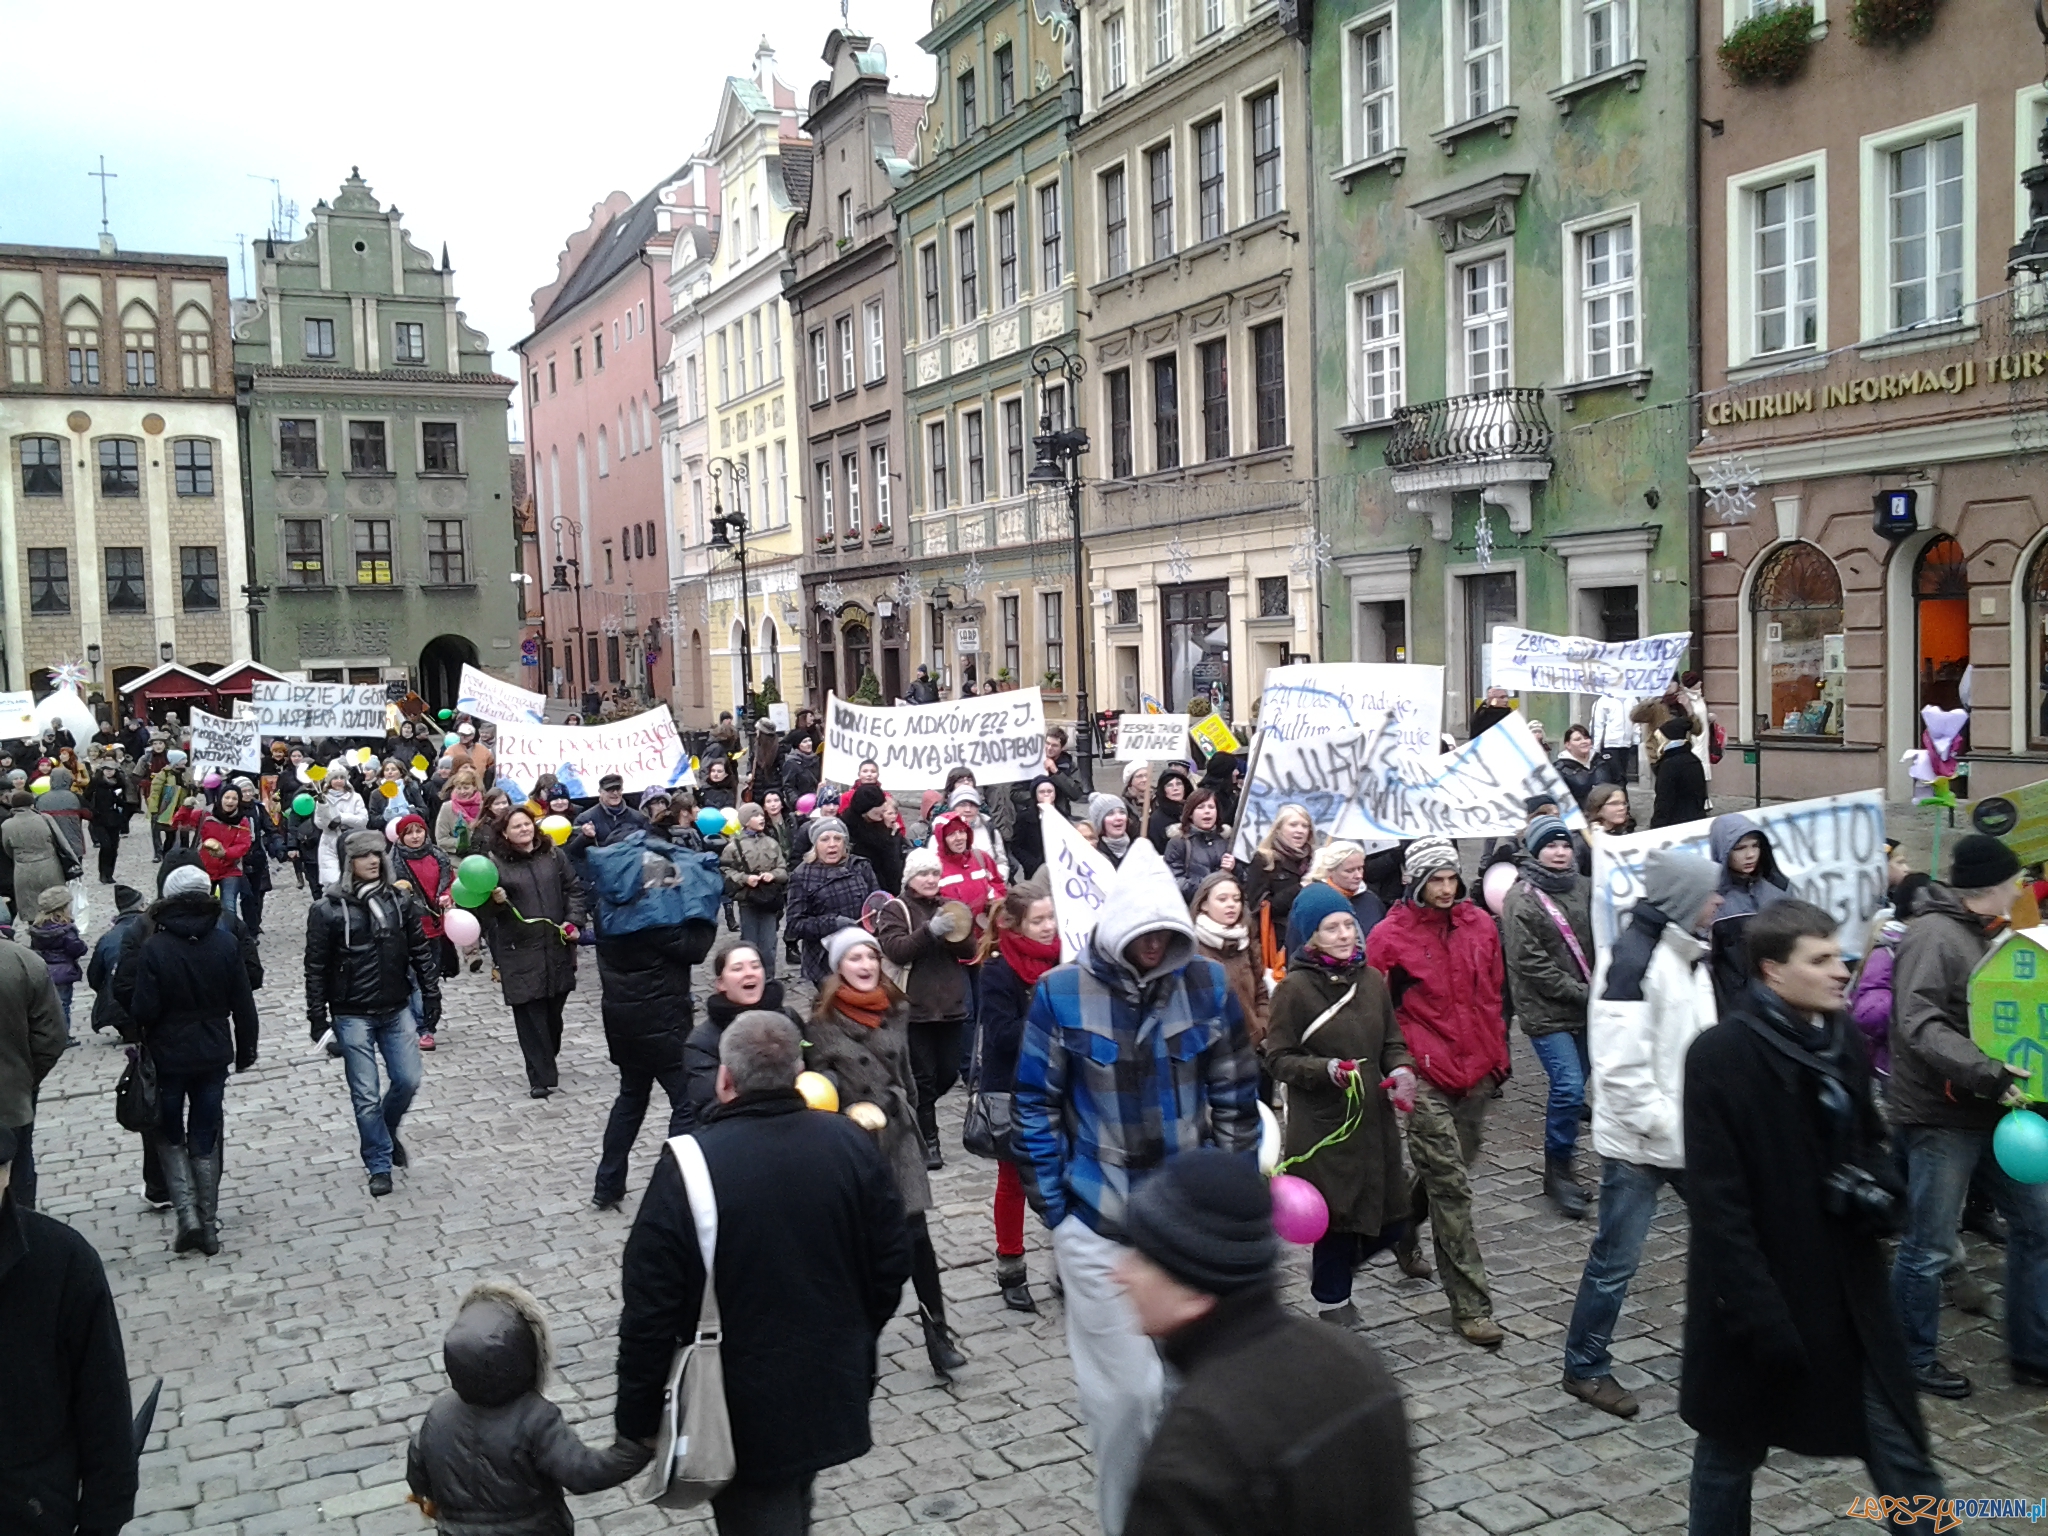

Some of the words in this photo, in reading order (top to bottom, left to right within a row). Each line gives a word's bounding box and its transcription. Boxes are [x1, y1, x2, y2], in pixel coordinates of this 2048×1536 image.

[1707, 388, 1814, 426] CENTRUM
[1821, 359, 1976, 409] INFORMACJI
[1986, 350, 2048, 384] TUR
[341, 686, 355, 704] W
[202, 715, 261, 736] RATUJMY
[834, 704, 897, 738] KONIEC
[881, 744, 943, 776] MNĄ
